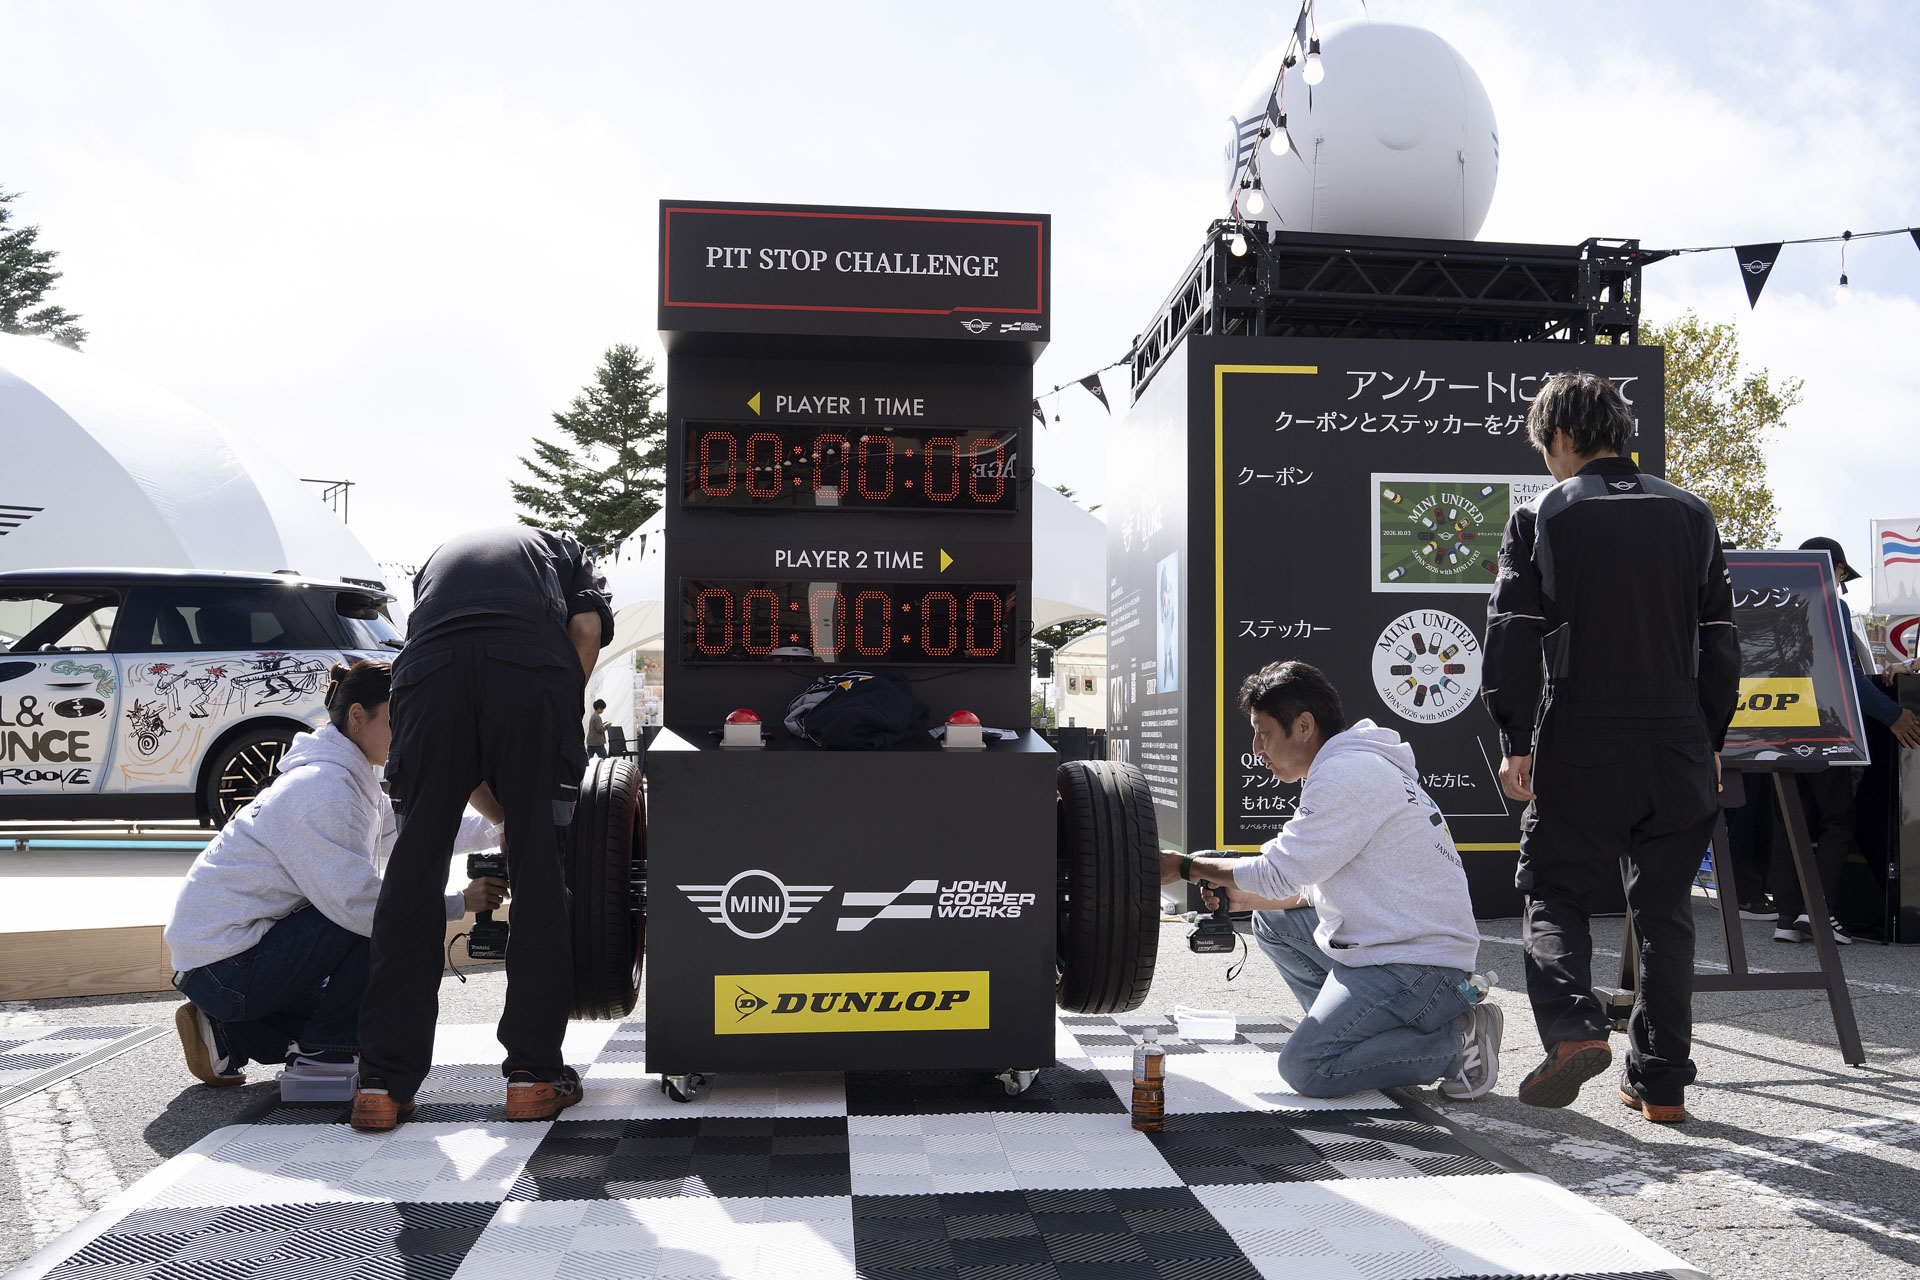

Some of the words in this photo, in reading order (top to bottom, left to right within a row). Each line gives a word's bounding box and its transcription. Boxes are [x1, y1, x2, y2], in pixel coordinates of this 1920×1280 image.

[705, 246, 752, 270] PIT
[759, 248, 829, 273] STOP
[835, 250, 1000, 278] CHALLENGE
[775, 396, 851, 416] PLAYER
[859, 397, 867, 415] 1
[874, 397, 925, 417] TIME
[700, 431, 1006, 503] 00:00:00
[1238, 466, 1314, 486] クーポン
[1513, 483, 1554, 493] これから
[1408, 495, 1438, 523] MINI
[1441, 493, 1484, 527] UNITED.
[775, 550, 850, 569] PLAYER
[855, 551, 868, 569] 2
[873, 551, 924, 569] TIME
[1412, 549, 1427, 566] JAPAN
[1425, 563, 1439, 574] 2026
[1453, 562, 1468, 575] MINI
[1467, 550, 1481, 567] LIVE!
[696, 588, 1003, 657] 00:00:00
[1238, 619, 1332, 639] ステッカー
[1378, 615, 1417, 653] MINI
[1421, 612, 1478, 657] UNITED.
[15, 695, 44, 727] &
[1382, 687, 1401, 709] JAPAN
[1400, 705, 1418, 719] 2026
[1419, 712, 1437, 721] with
[1437, 705, 1458, 720] MINI
[1456, 687, 1474, 709] LIVE!
[1241, 795, 1301, 810] もれなく
[1434, 842, 1455, 863] JAPAN
[941, 880, 1007, 893] JOHN
[730, 895, 780, 913] MINI
[938, 893, 1036, 906] COOPER
[937, 905, 1021, 919] WORKS
[770, 990, 971, 1015] DUNLOP
